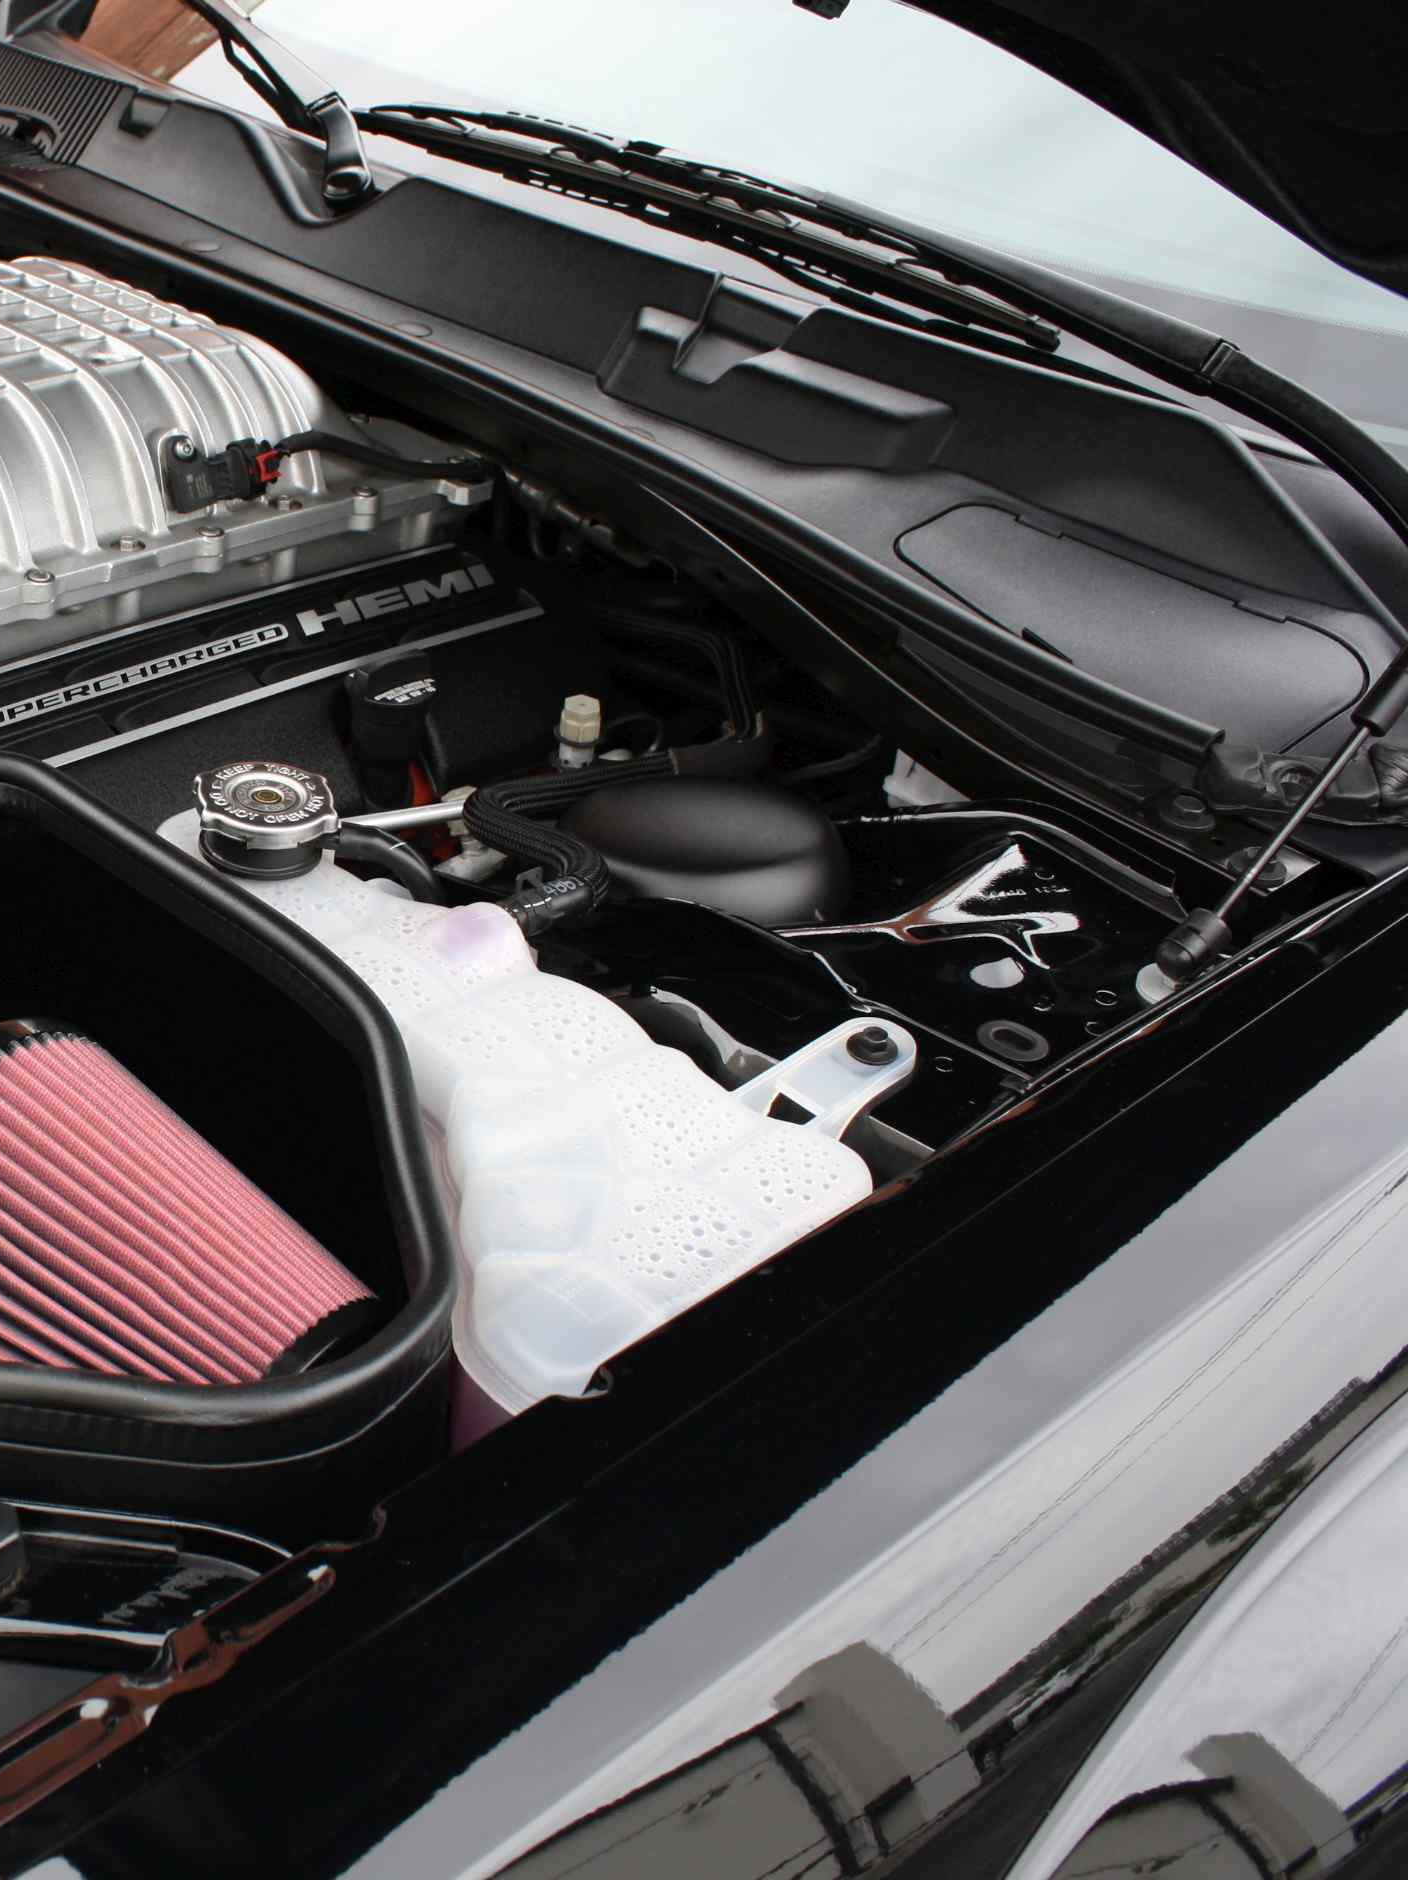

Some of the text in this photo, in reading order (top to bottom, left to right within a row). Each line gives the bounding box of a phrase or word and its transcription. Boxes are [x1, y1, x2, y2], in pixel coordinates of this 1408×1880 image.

[295, 565, 495, 637] HEMI
[215, 763, 255, 780] KEEP
[263, 809, 310, 824] OPEN
